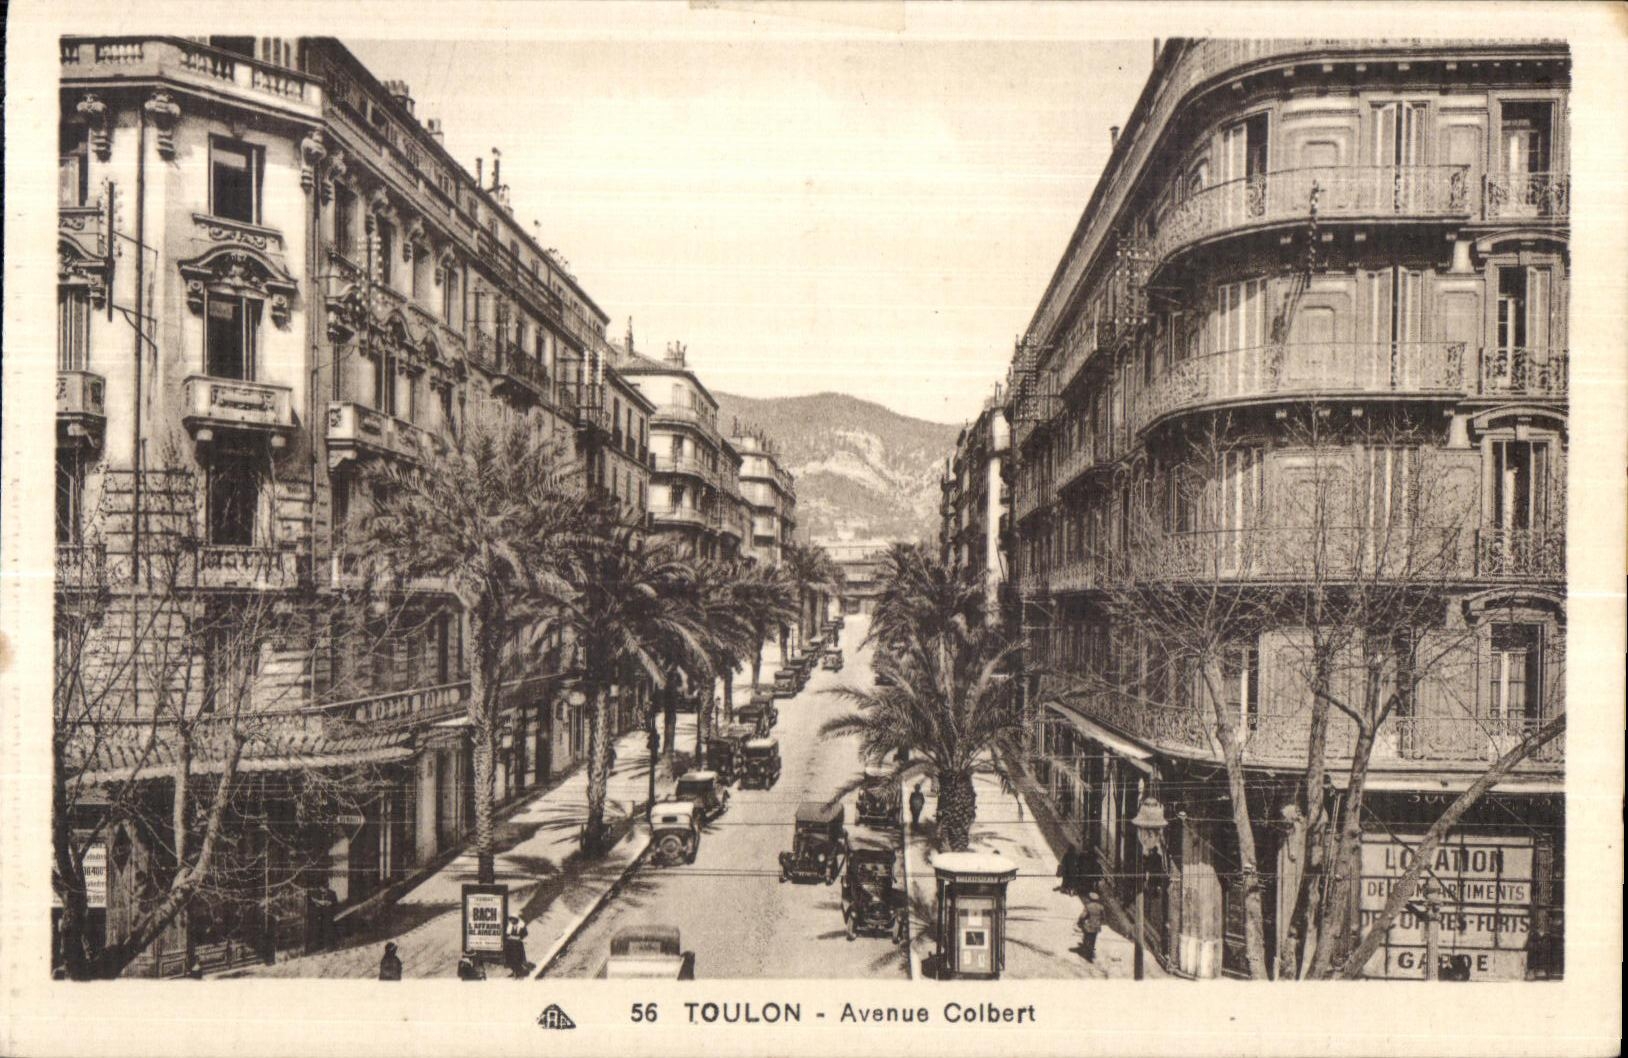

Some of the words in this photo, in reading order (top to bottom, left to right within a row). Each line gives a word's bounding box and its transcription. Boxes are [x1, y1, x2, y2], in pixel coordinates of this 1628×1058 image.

[1385, 847, 1504, 873] LOATION
[1367, 881, 1385, 897] DE
[472, 907, 498, 922] BACH
